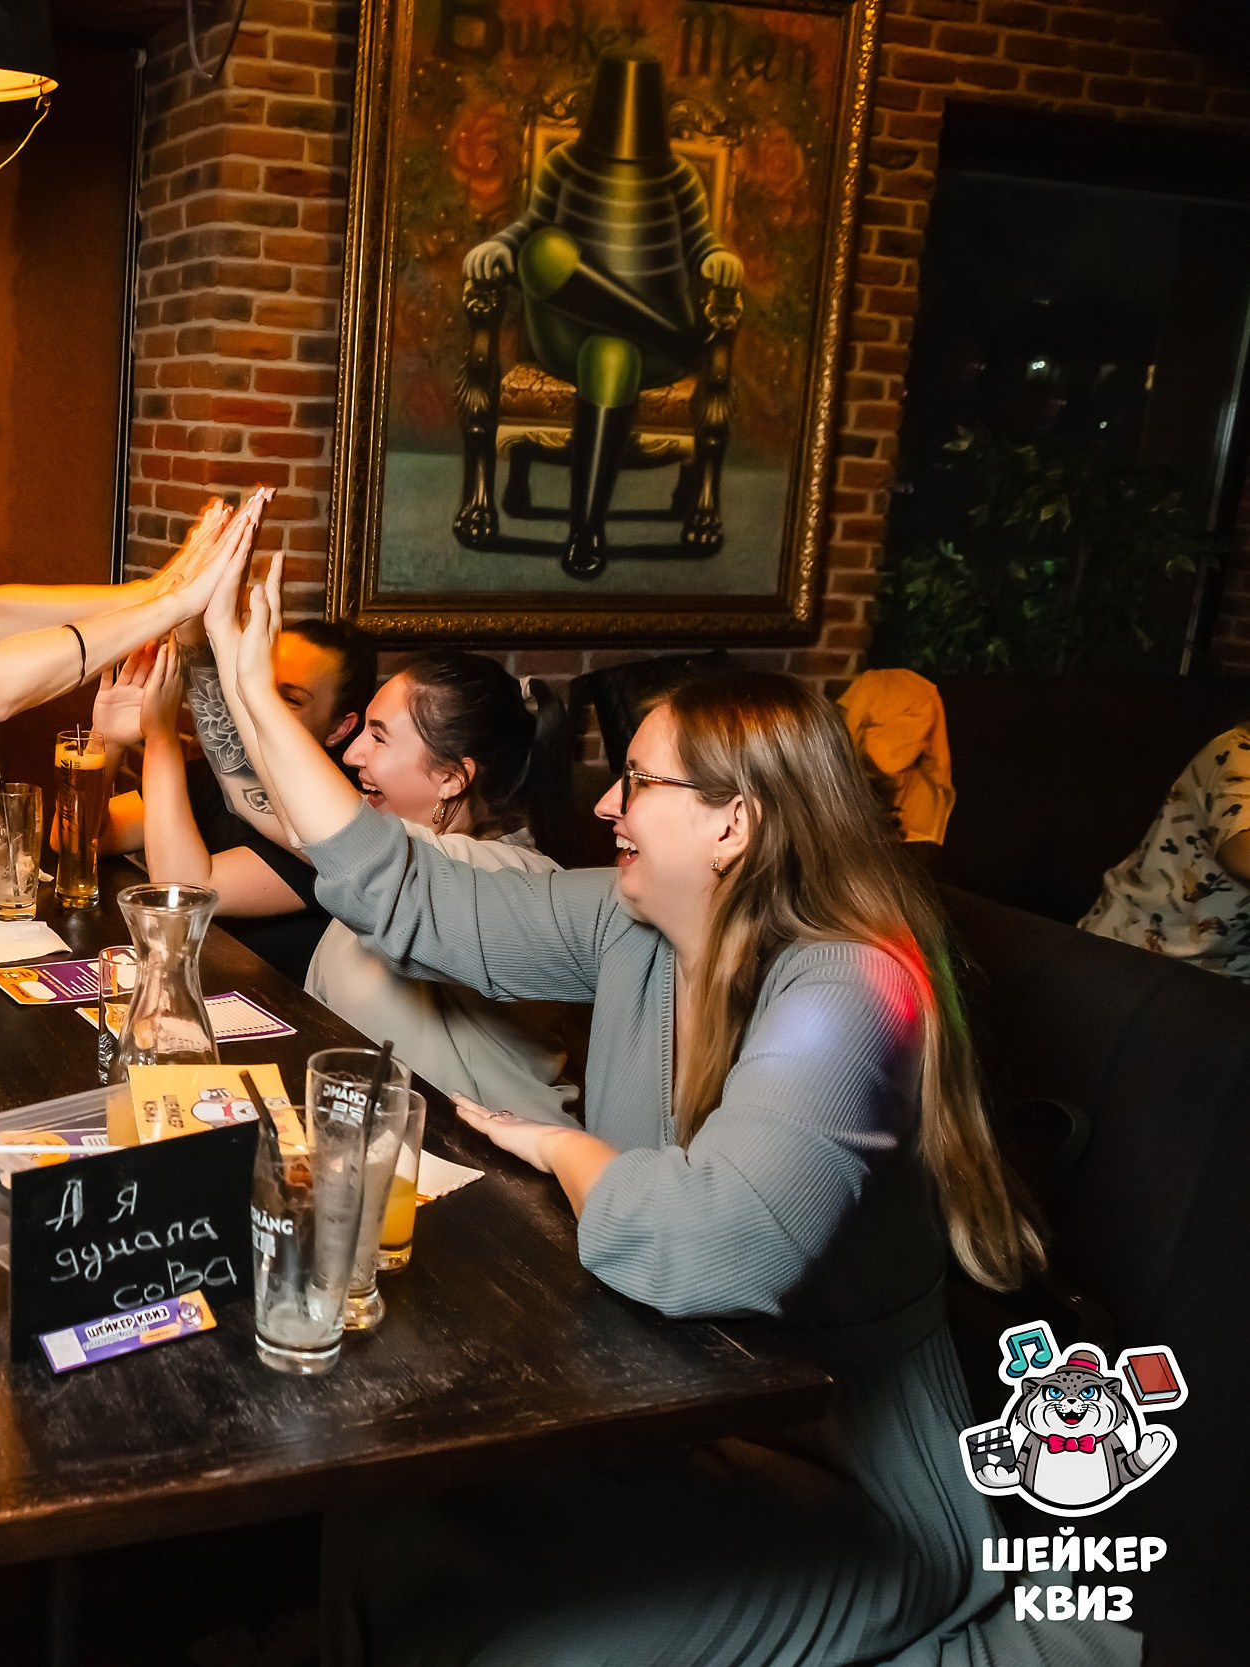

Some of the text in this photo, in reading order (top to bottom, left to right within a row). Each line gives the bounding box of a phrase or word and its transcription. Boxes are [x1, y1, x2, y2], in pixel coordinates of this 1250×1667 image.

[678, 9, 814, 83] Man
[45, 1179, 85, 1232] А
[50, 1216, 219, 1282] думала
[136, 1307, 168, 1325] КВИЗ
